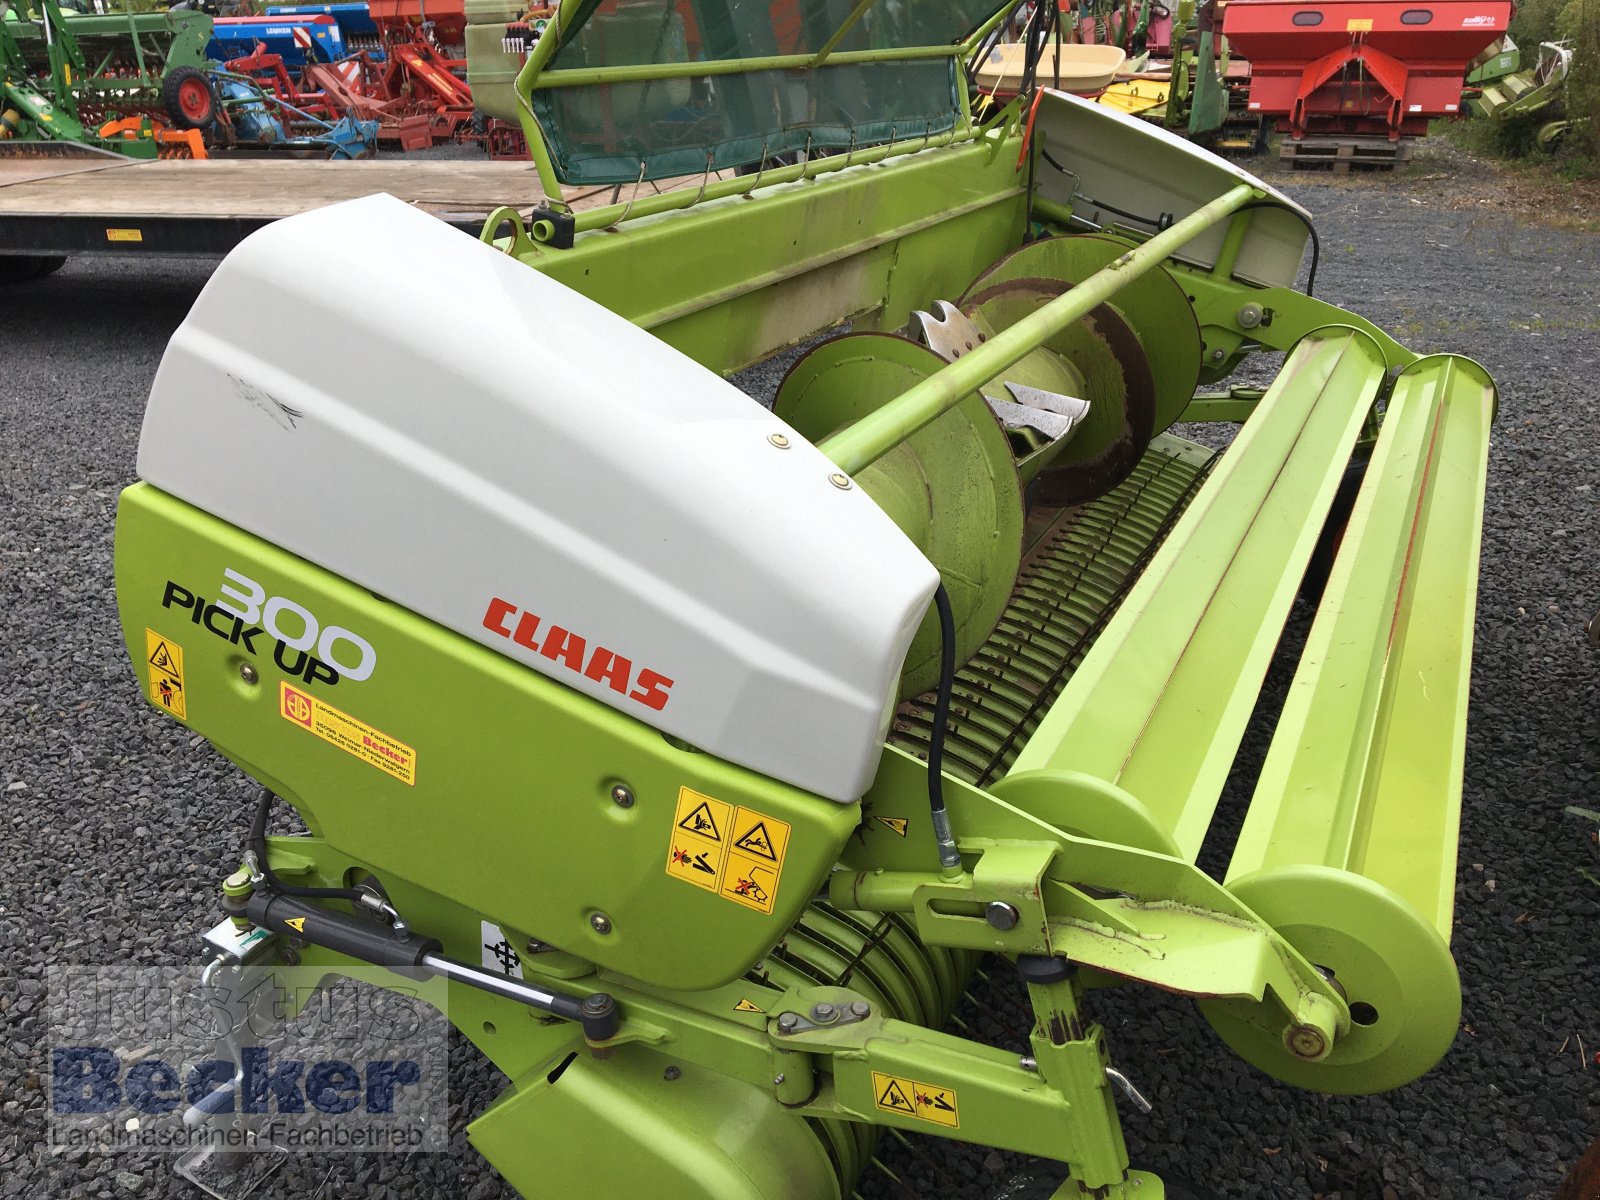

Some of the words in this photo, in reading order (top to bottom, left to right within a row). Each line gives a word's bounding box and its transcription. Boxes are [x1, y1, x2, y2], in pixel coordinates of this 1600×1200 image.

[162, 580, 264, 656] PICK
[273, 639, 340, 685] UP
[216, 567, 376, 681] 300
[483, 597, 674, 711] CLAAS
[315, 702, 410, 756] Landmaschinen-Fachbetrieb
[363, 734, 407, 766] Becker
[370, 755, 380, 764] Fax
